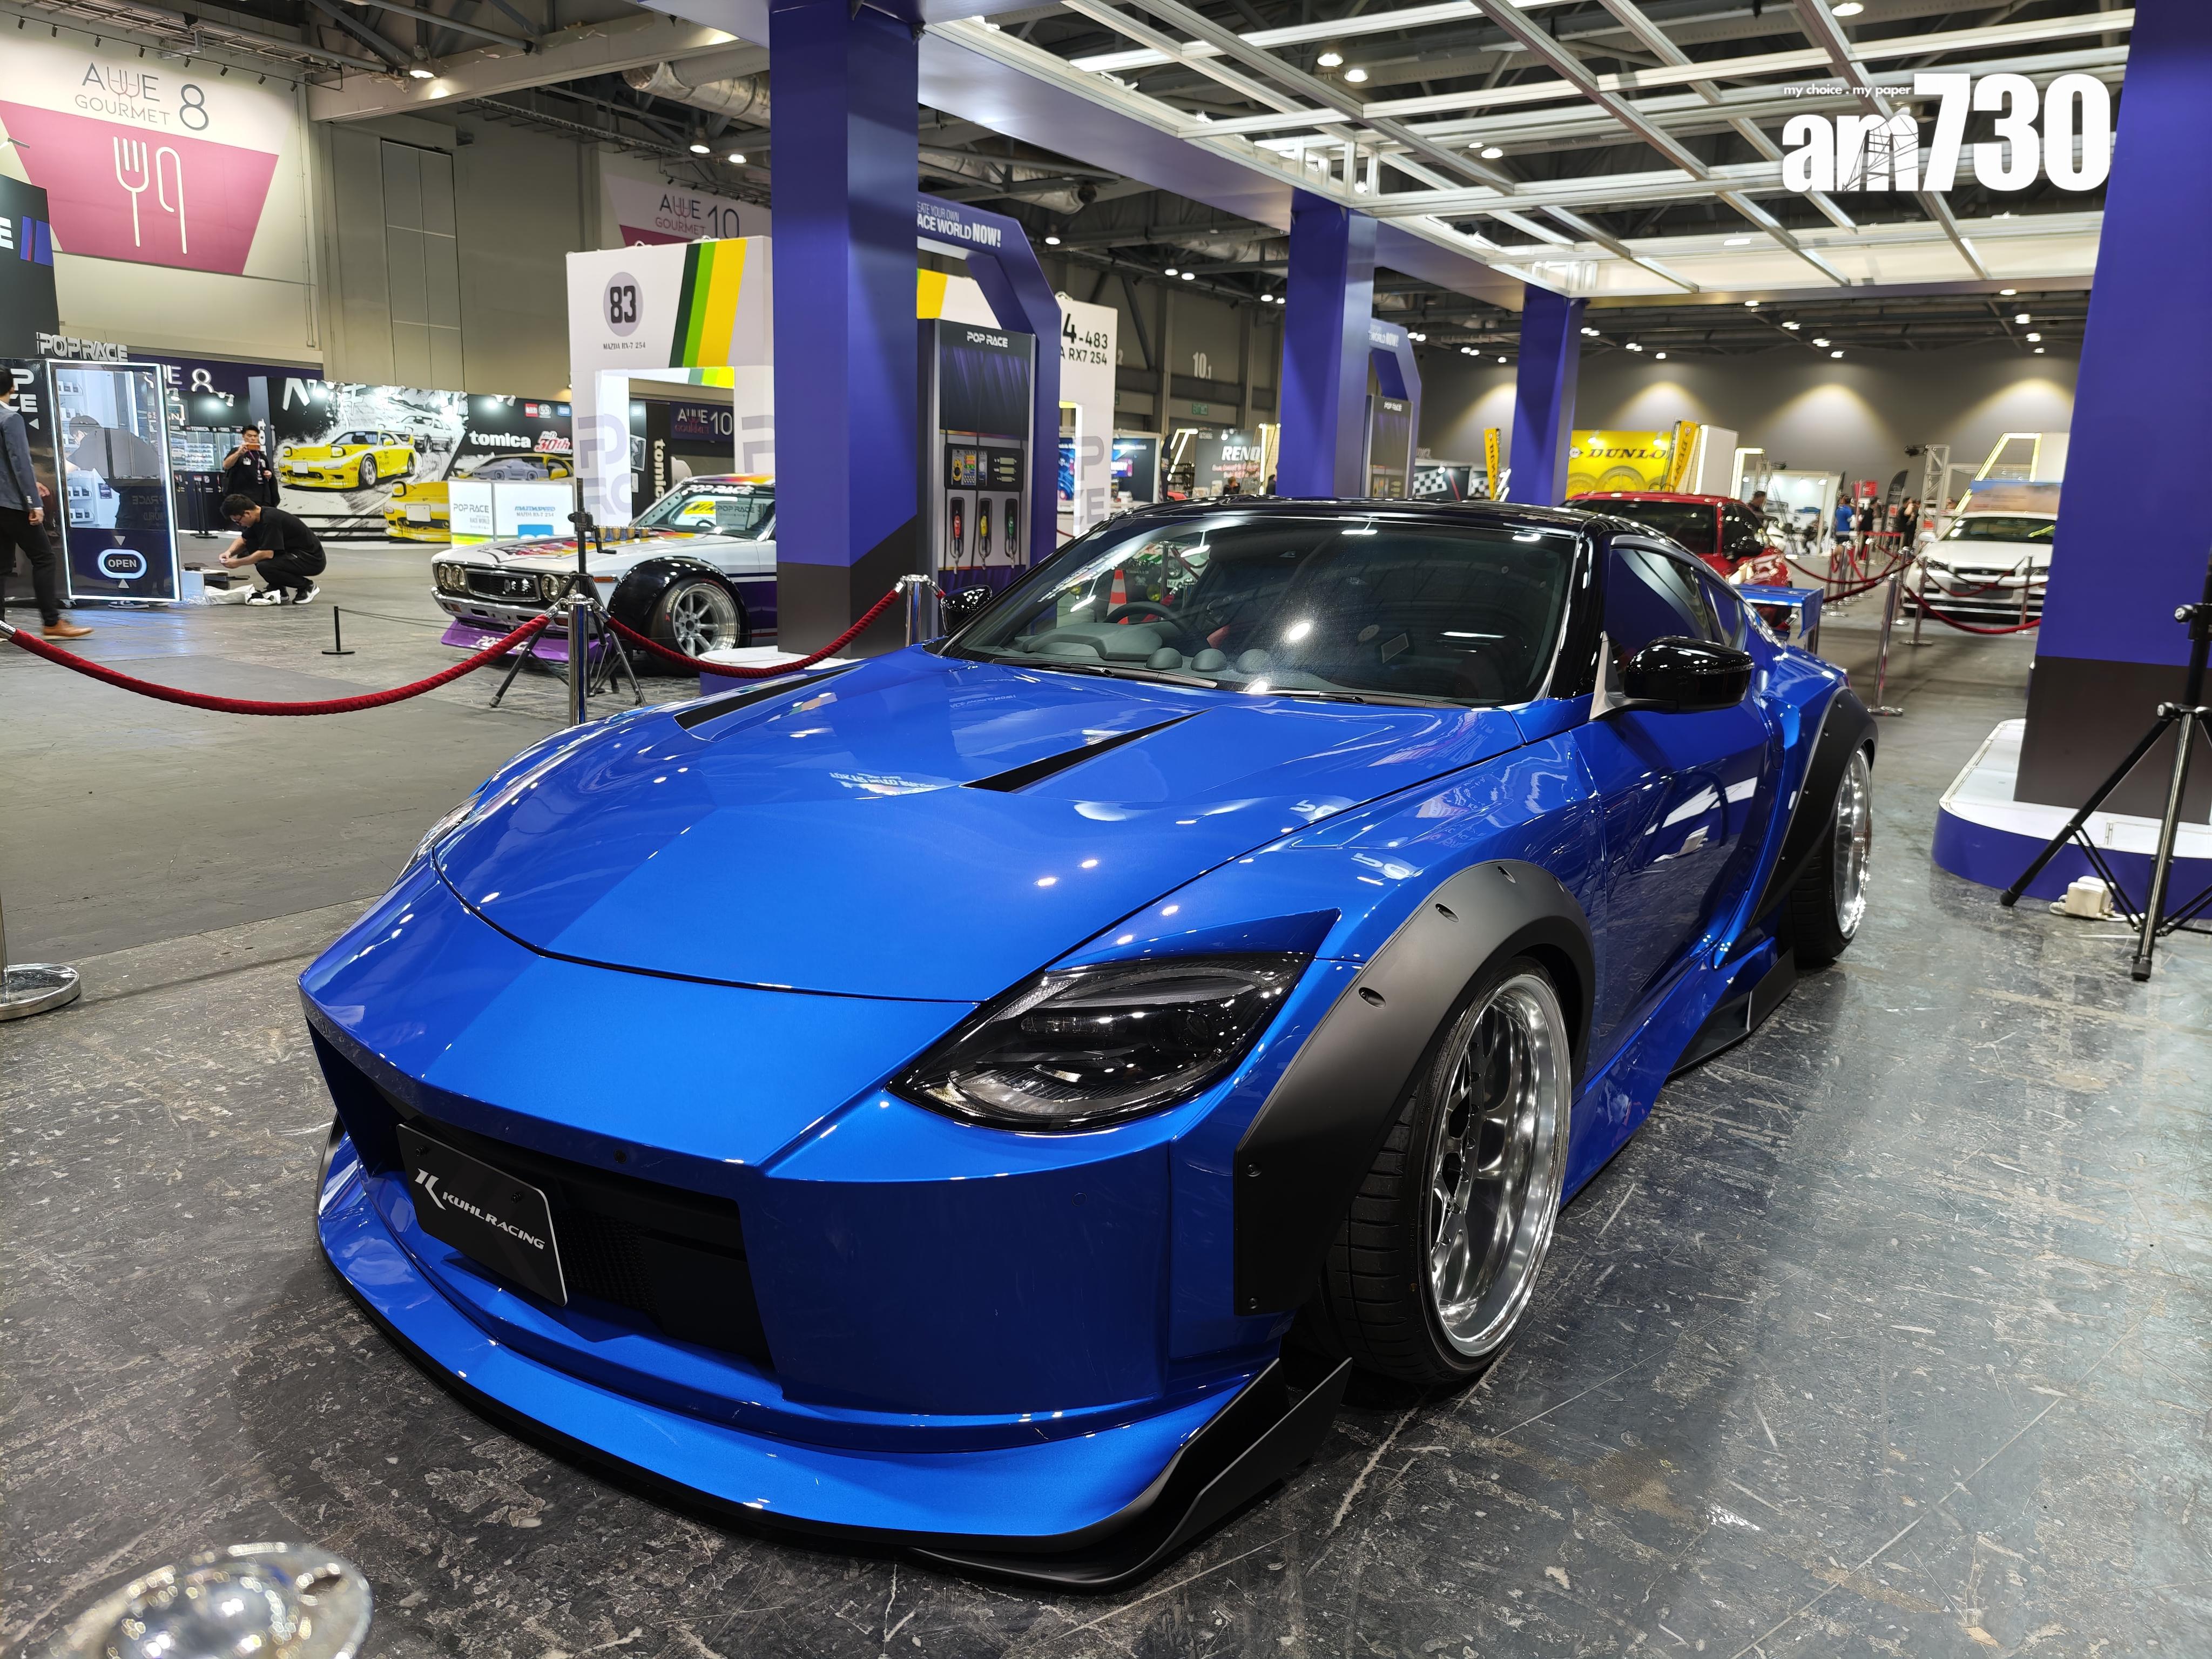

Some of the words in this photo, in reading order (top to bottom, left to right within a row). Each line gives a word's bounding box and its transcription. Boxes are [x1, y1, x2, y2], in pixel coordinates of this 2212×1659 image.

[75, 94, 170, 125] GOURMET
[179, 84, 209, 131] 8
[708, 205, 739, 238] 10
[930, 206, 946, 219] YOUR
[947, 210, 960, 222] OWN
[655, 217, 706, 235] GOURMET
[917, 213, 936, 231] ACE
[937, 218, 972, 240] WORLD
[972, 222, 1001, 248] NOW!
[610, 285, 636, 323] 83
[36, 332, 81, 359] POP
[78, 339, 129, 362] RACE
[967, 331, 986, 343] POP
[986, 334, 1008, 348] RACE
[1069, 348, 1087, 362] RX7
[1090, 351, 1107, 366] 254
[711, 412, 732, 435] 10
[469, 430, 531, 448] tomica
[536, 438, 570, 451] 30th
[454, 503, 468, 512] POP
[469, 504, 489, 513] RACE
[108, 559, 137, 568] OPEN
